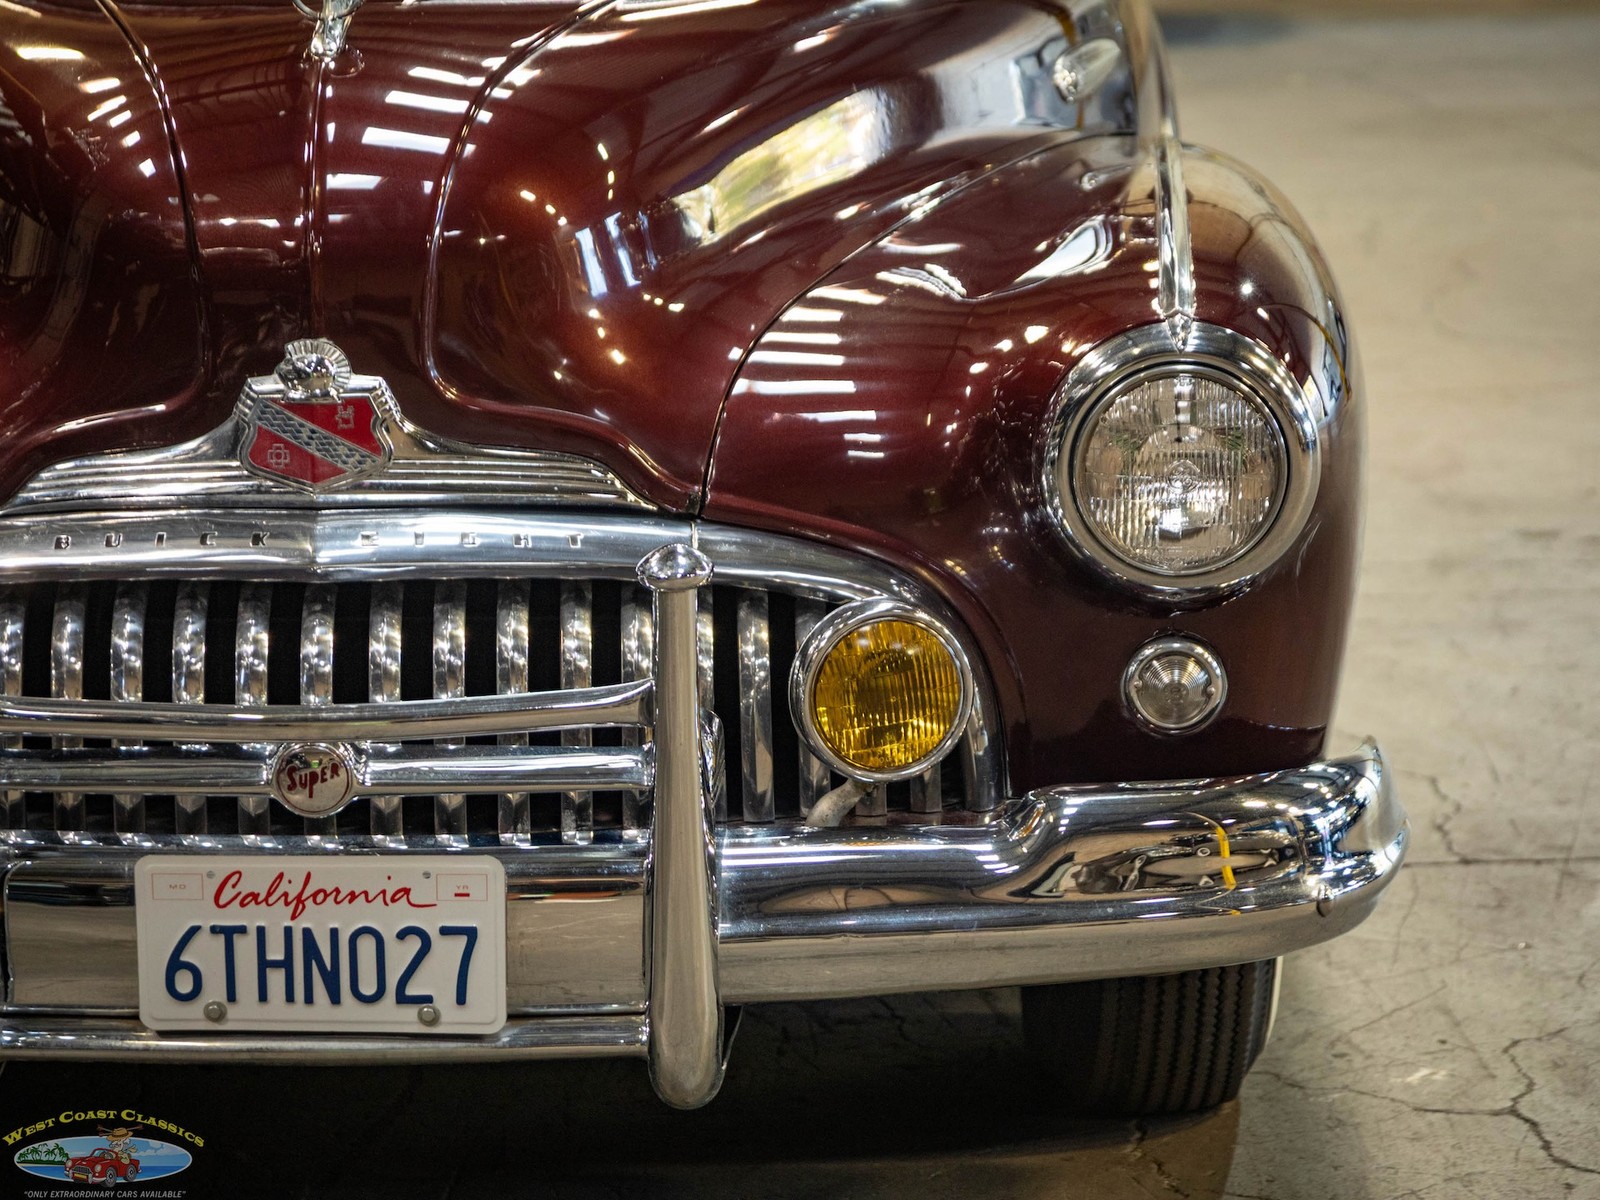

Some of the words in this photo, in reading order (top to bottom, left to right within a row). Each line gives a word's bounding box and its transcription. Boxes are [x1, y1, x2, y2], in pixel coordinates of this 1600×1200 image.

[53, 531, 271, 550] BUICK
[360, 530, 584, 548] EIGHT
[213, 870, 438, 921] California
[165, 924, 478, 1005] 6THN027
